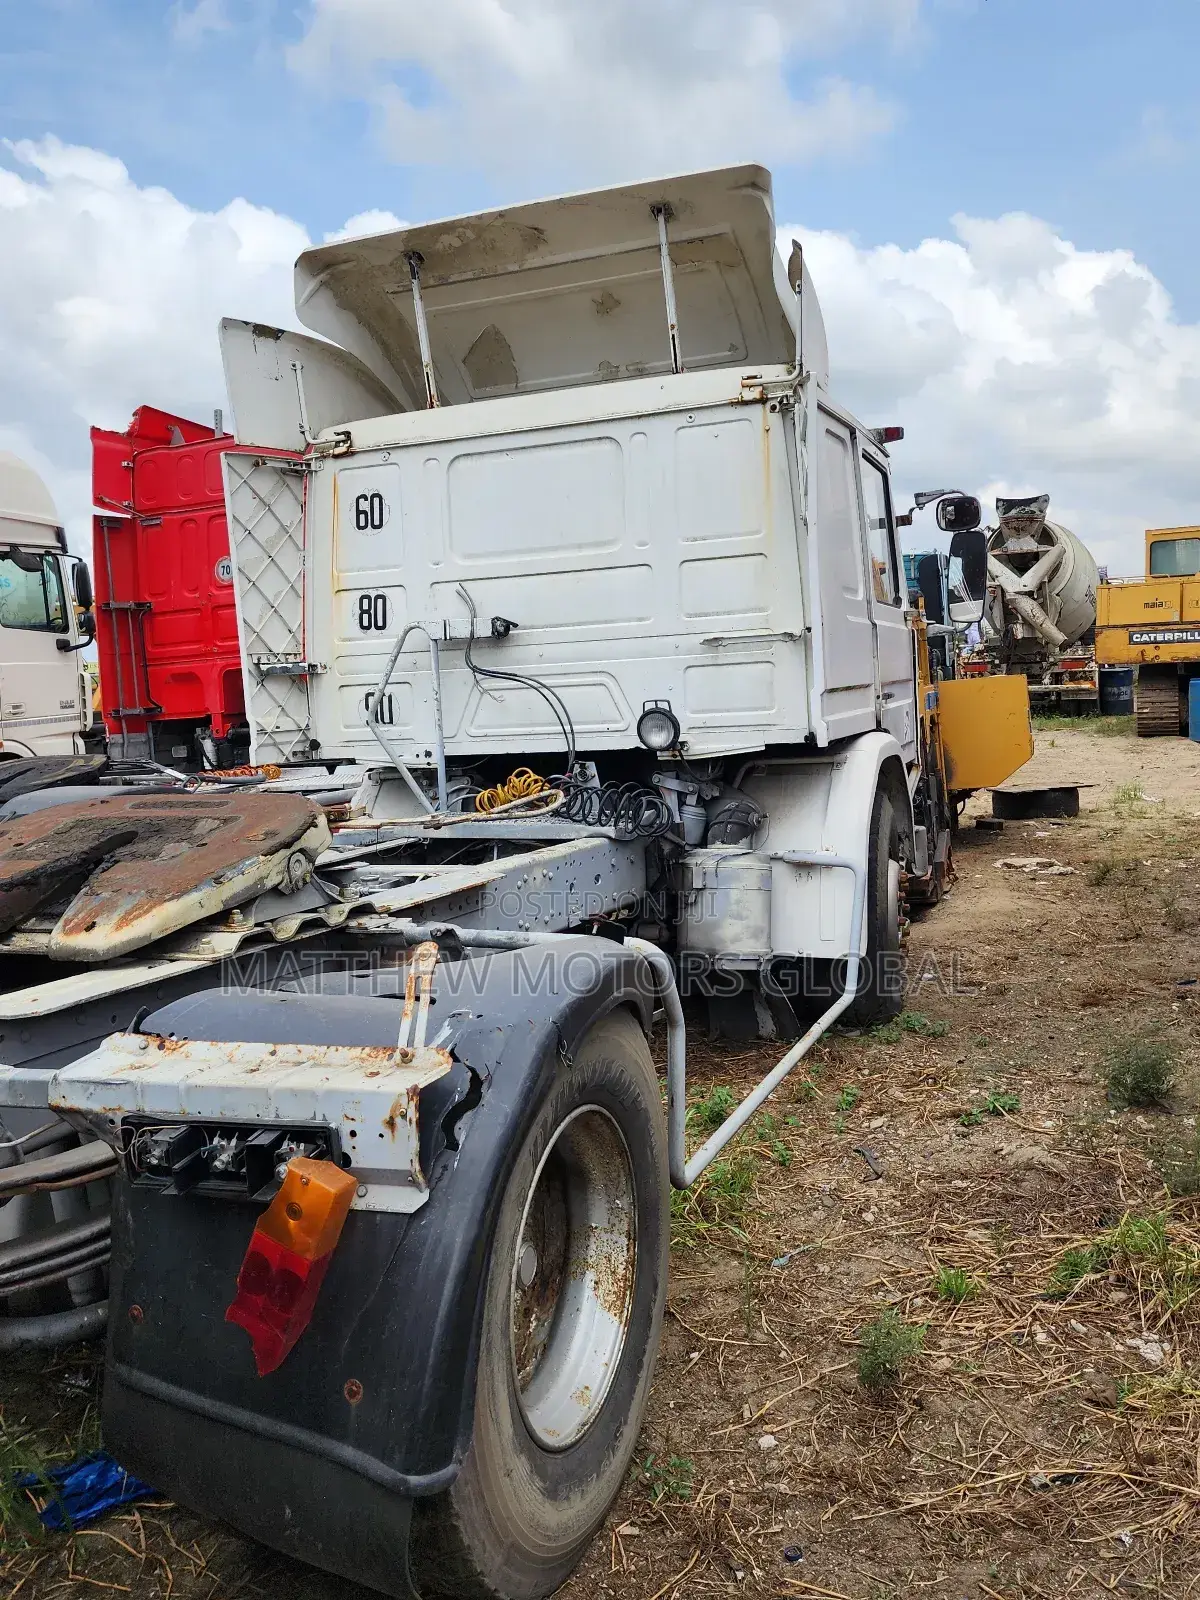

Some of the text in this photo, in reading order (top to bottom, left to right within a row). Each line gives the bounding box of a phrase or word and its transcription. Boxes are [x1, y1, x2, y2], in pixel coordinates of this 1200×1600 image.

[355, 493, 384, 530] 60
[221, 565, 231, 576] 70
[358, 594, 387, 630] 80
